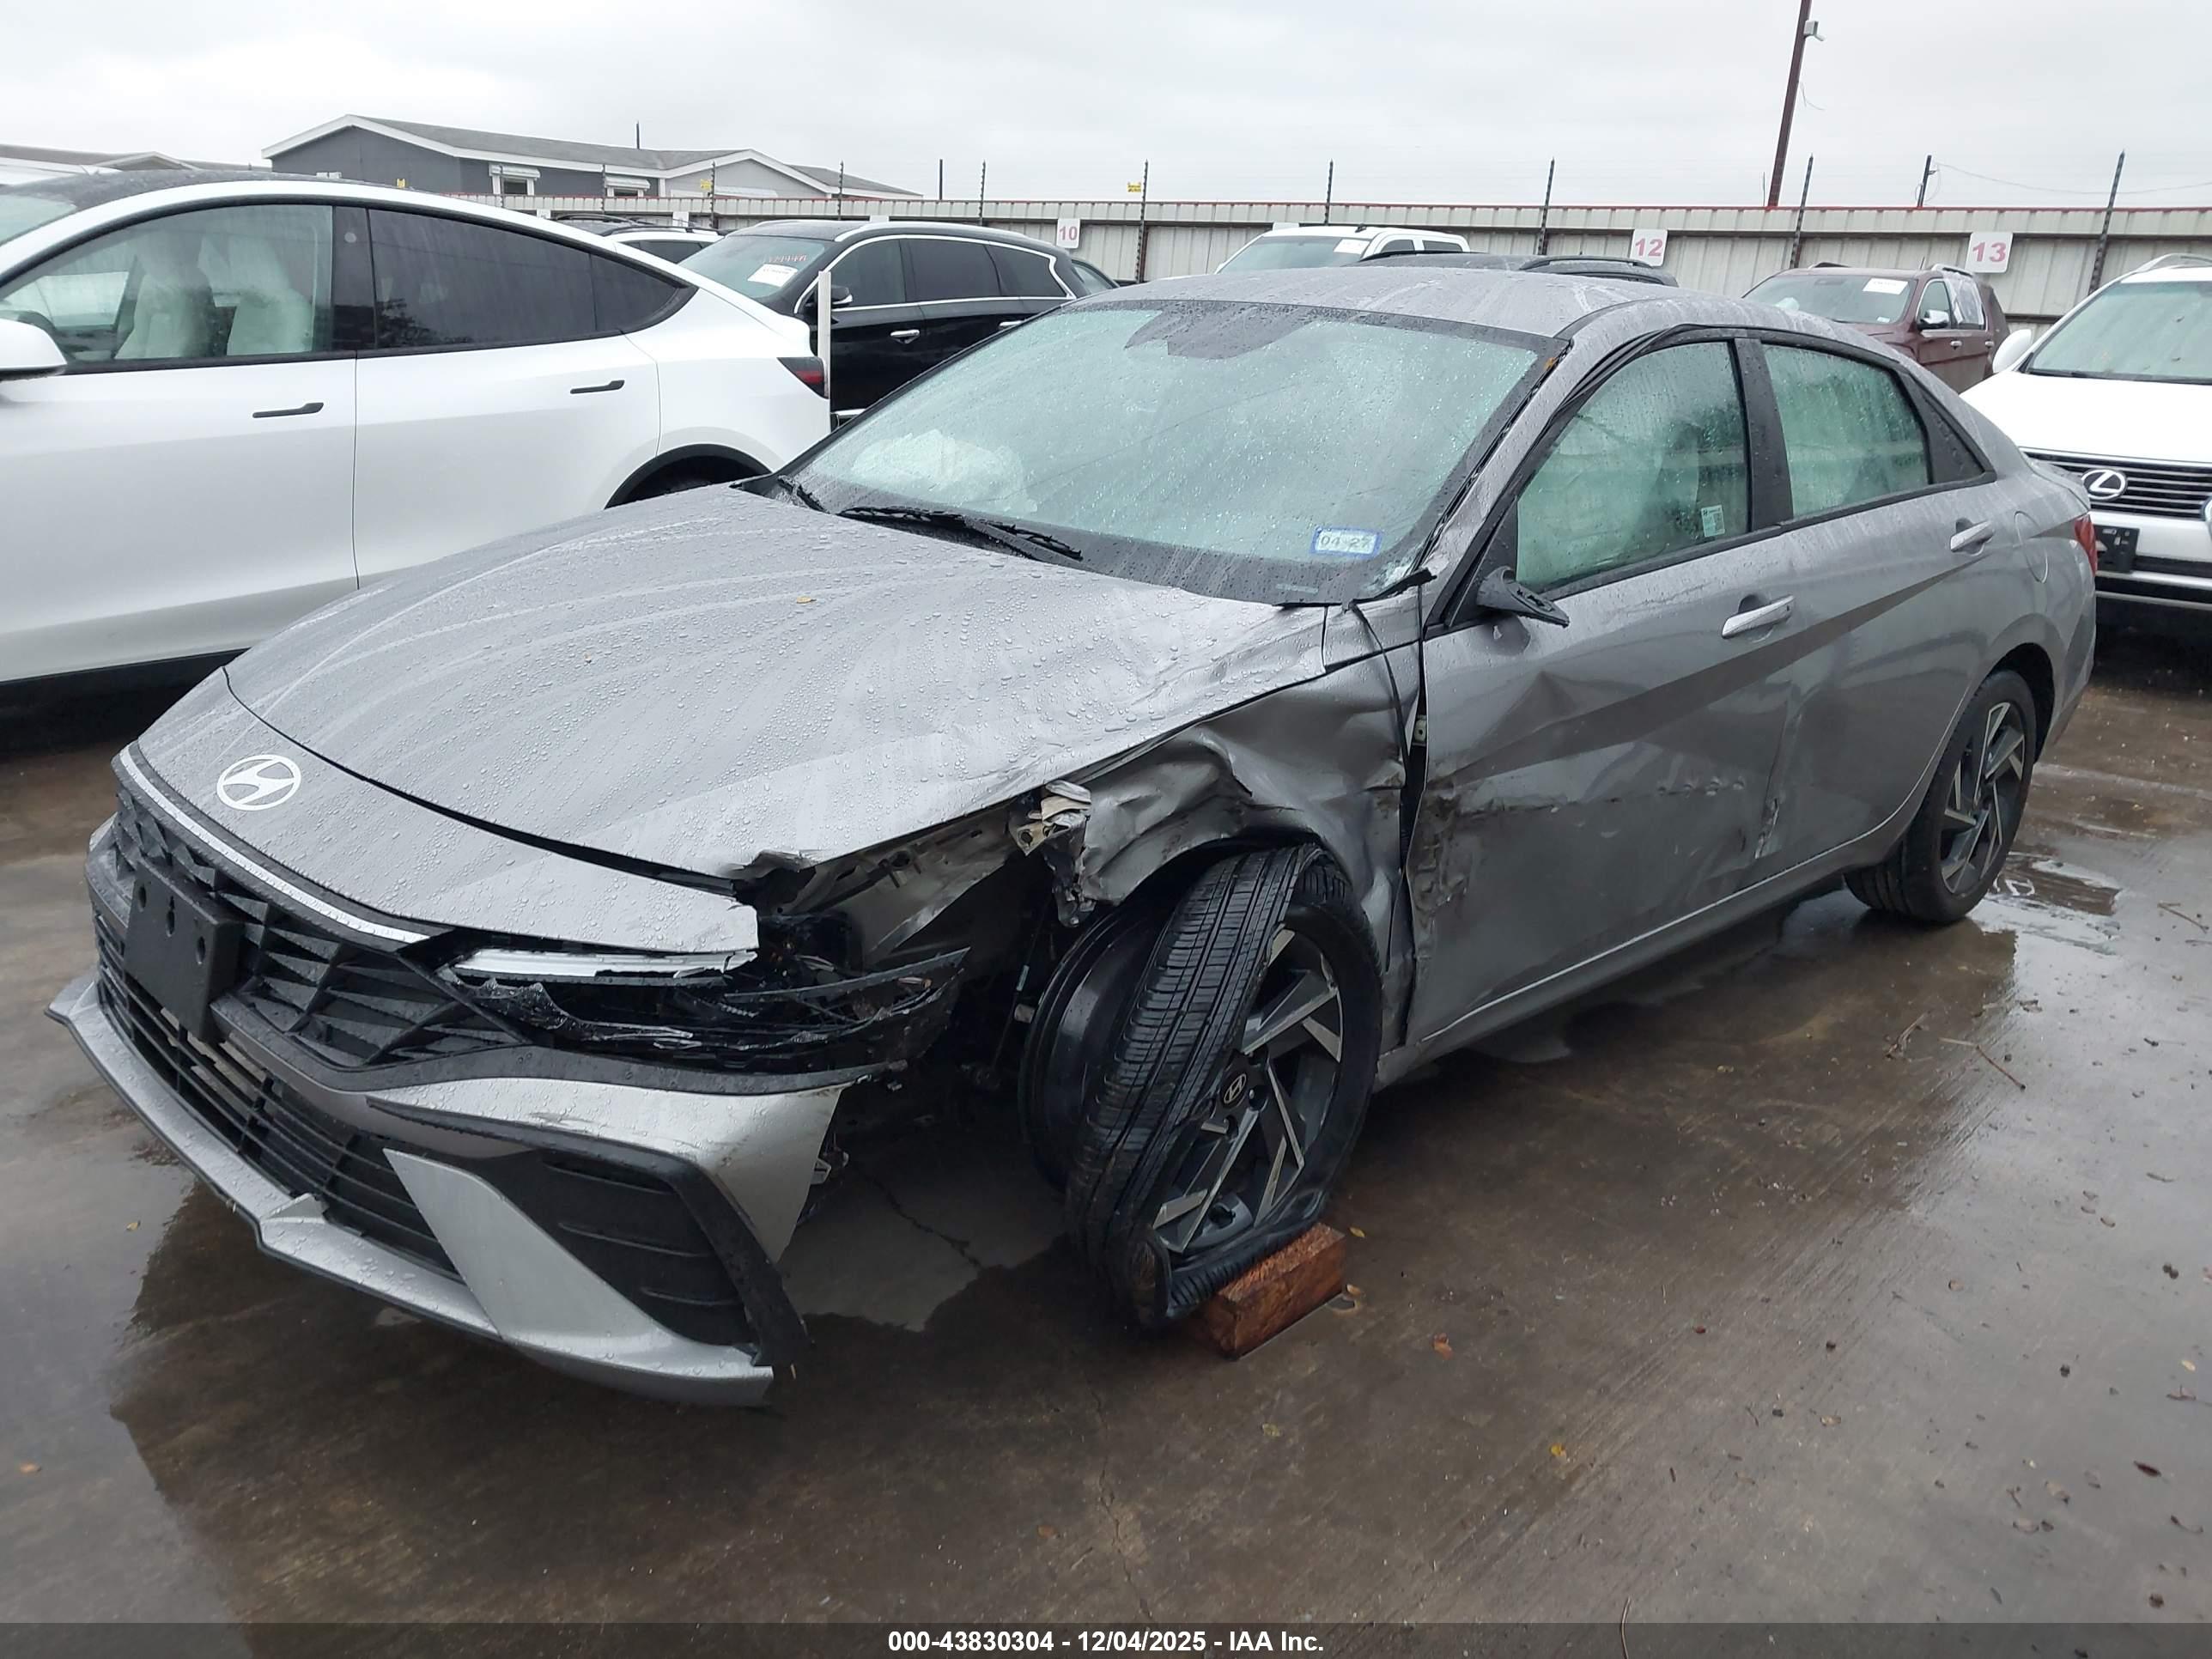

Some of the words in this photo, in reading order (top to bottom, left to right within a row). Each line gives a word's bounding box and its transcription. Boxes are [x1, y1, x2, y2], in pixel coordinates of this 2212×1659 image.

[1059, 226, 1078, 240] 10
[1635, 238, 1663, 257] 12
[1972, 241, 2007, 262] 13
